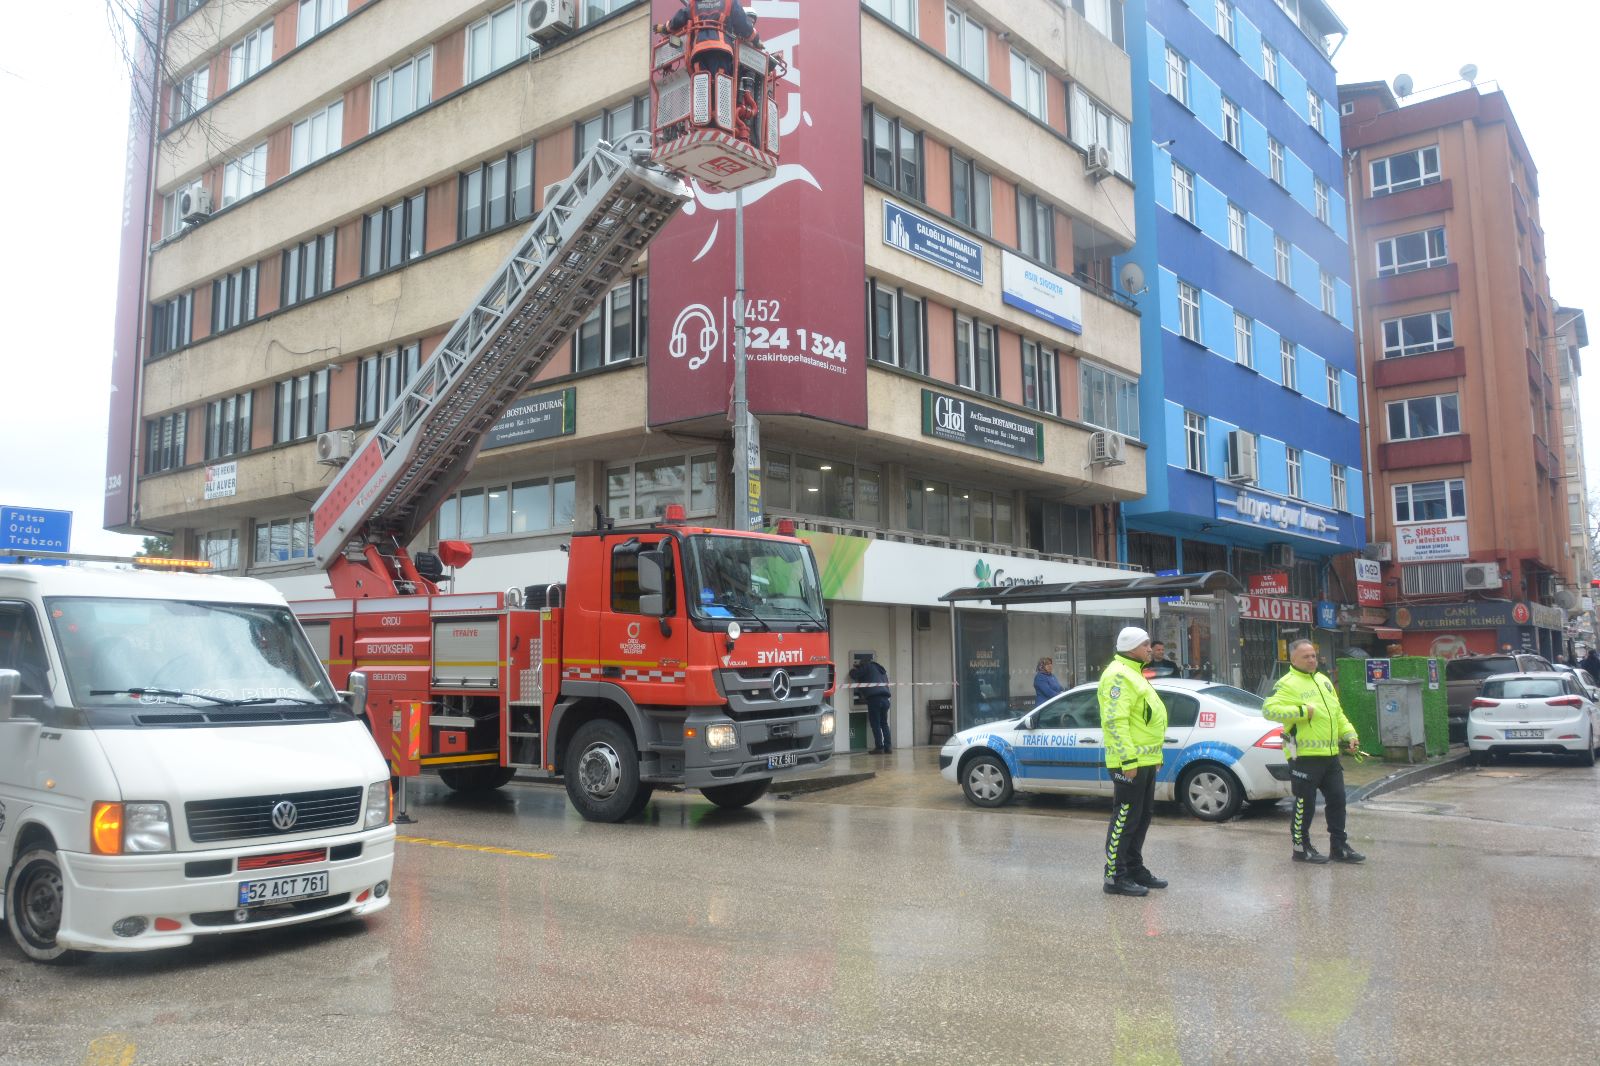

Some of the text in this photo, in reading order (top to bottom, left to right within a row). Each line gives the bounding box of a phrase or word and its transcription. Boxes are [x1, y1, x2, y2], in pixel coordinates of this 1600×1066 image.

[946, 236, 977, 258] MİMARLIK
[811, 332, 848, 363] 324
[506, 399, 563, 418] BOSTANCI DURAK
[217, 478, 236, 490] ALVER
[10, 512, 46, 523] Fatsa
[9, 524, 41, 534] Ordu
[1415, 526, 1448, 537] ŞİMŞEK
[9, 535, 62, 547] Trabzon
[381, 616, 401, 626] ORDU
[1201, 713, 1215, 722] 112
[1022, 732, 1077, 747] TRAFİK POLİSİ
[249, 883, 267, 900] 52
[271, 878, 298, 893] ACT
[302, 875, 325, 892] 761
